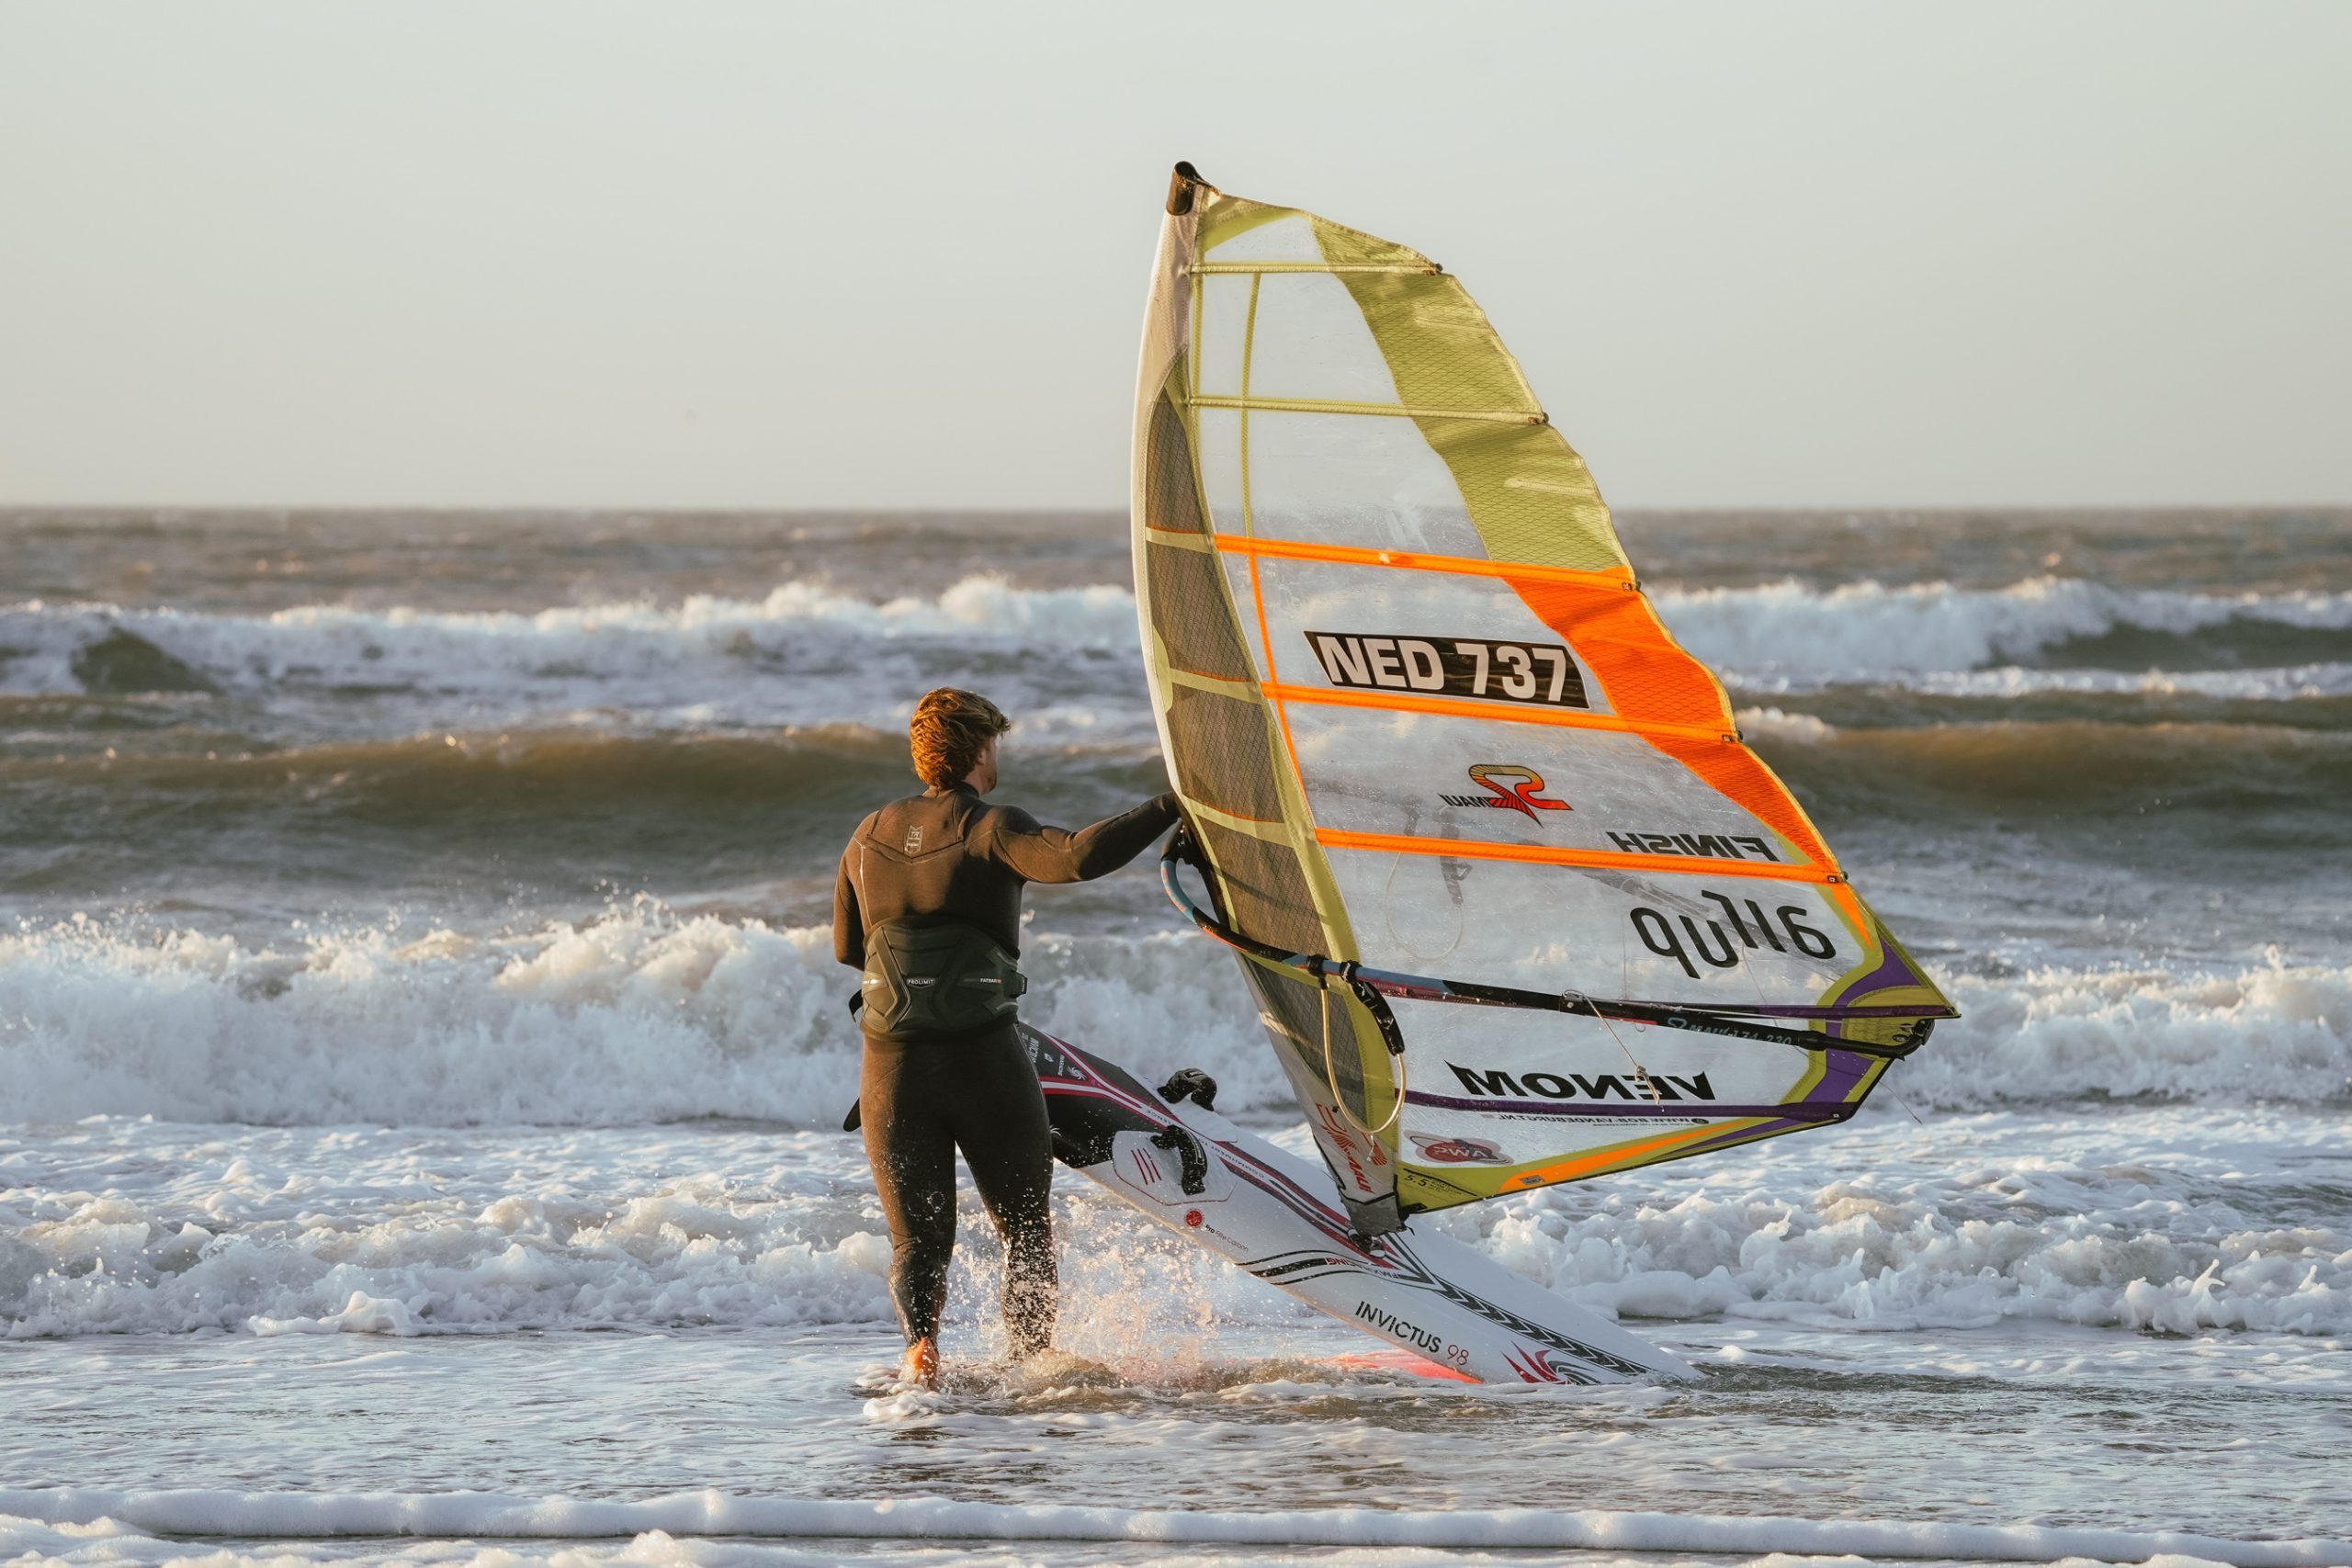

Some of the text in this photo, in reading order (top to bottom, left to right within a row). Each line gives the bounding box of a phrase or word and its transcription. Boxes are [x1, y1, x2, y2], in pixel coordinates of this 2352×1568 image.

[1316, 636, 1566, 702] NED 737
[1404, 1175, 1430, 1187] 5.5
[1355, 1301, 1469, 1365] INVICTUS 98
